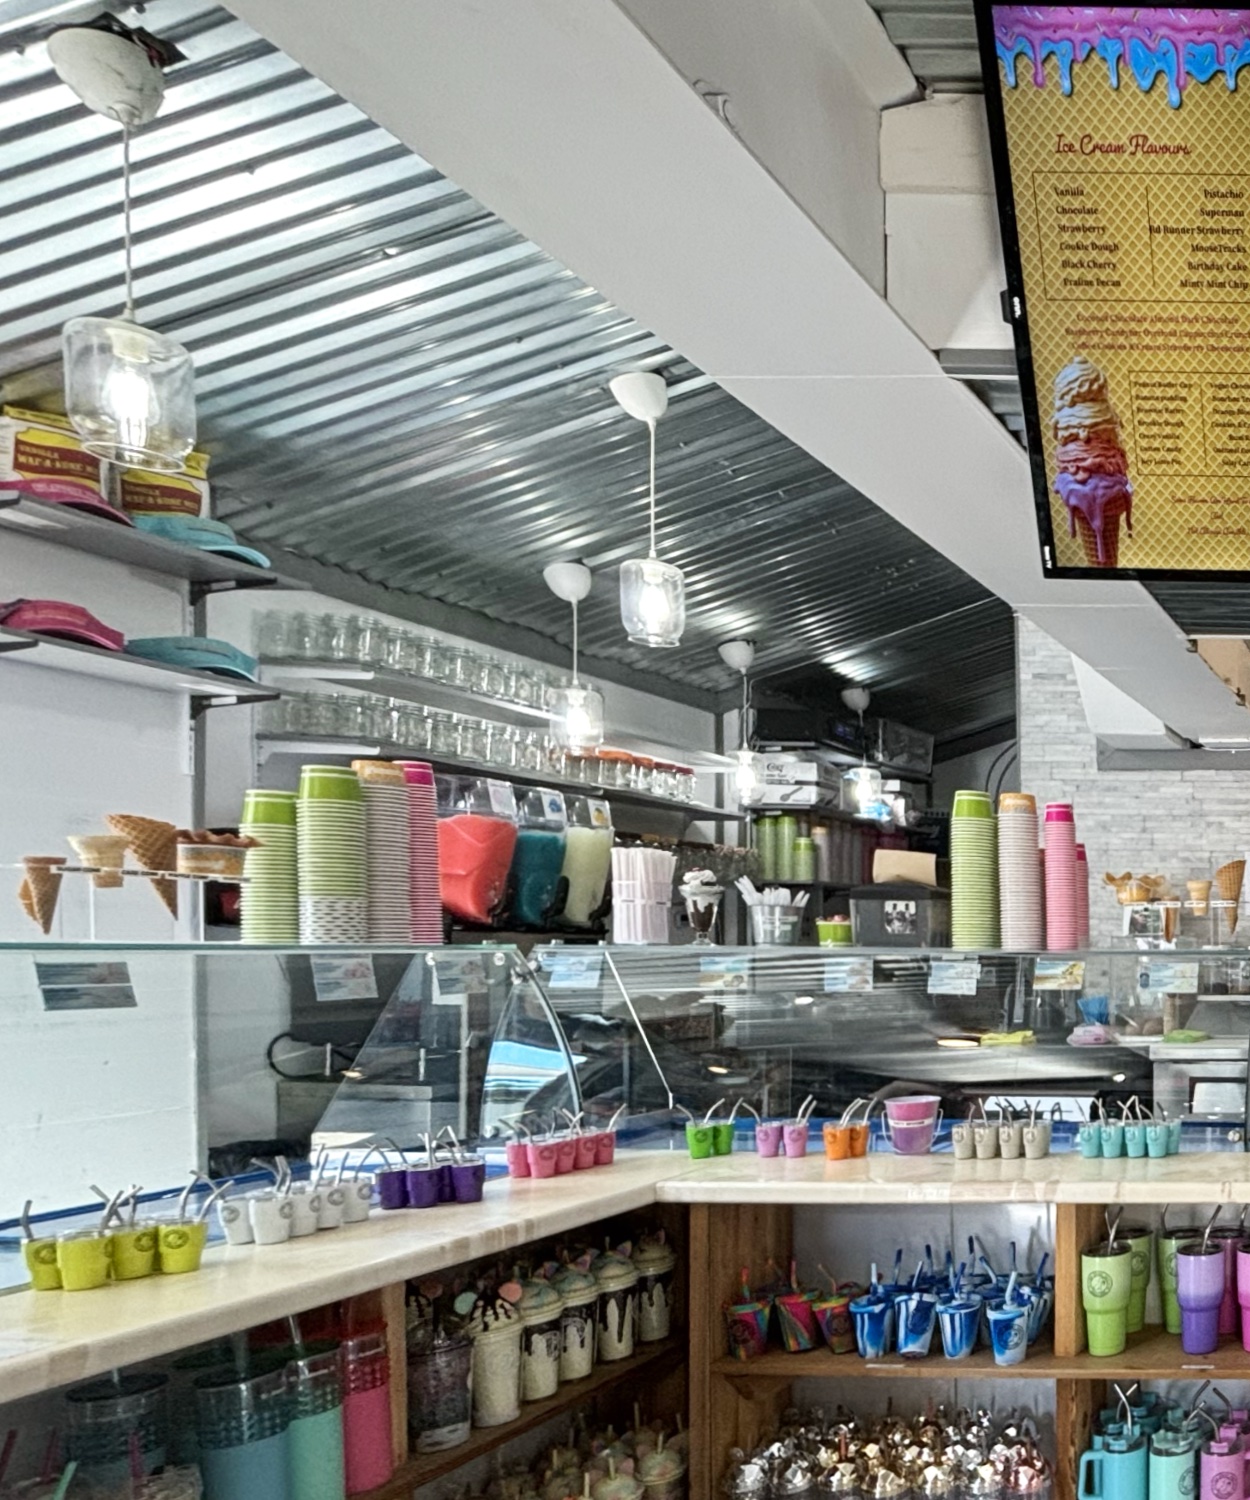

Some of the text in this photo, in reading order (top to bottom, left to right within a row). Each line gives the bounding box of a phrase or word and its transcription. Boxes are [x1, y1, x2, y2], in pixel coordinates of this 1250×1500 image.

[1055, 134, 1192, 155] Ice Cream Flavours
[1054, 187, 1084, 197] Vanilla
[1204, 189, 1244, 199] Pistachio
[1056, 206, 1099, 215] Chocolate
[1200, 208, 1244, 219] Superman
[1058, 224, 1105, 235] Strawberry
[1197, 226, 1244, 237] Strawberry
[1060, 242, 1119, 253] Cookie Dough
[1062, 260, 1116, 271] Black Cherry
[1188, 262, 1247, 273] Birthday Cake
[1063, 278, 1121, 286] Praline Pecan
[1228, 280, 1249, 291] Chip
